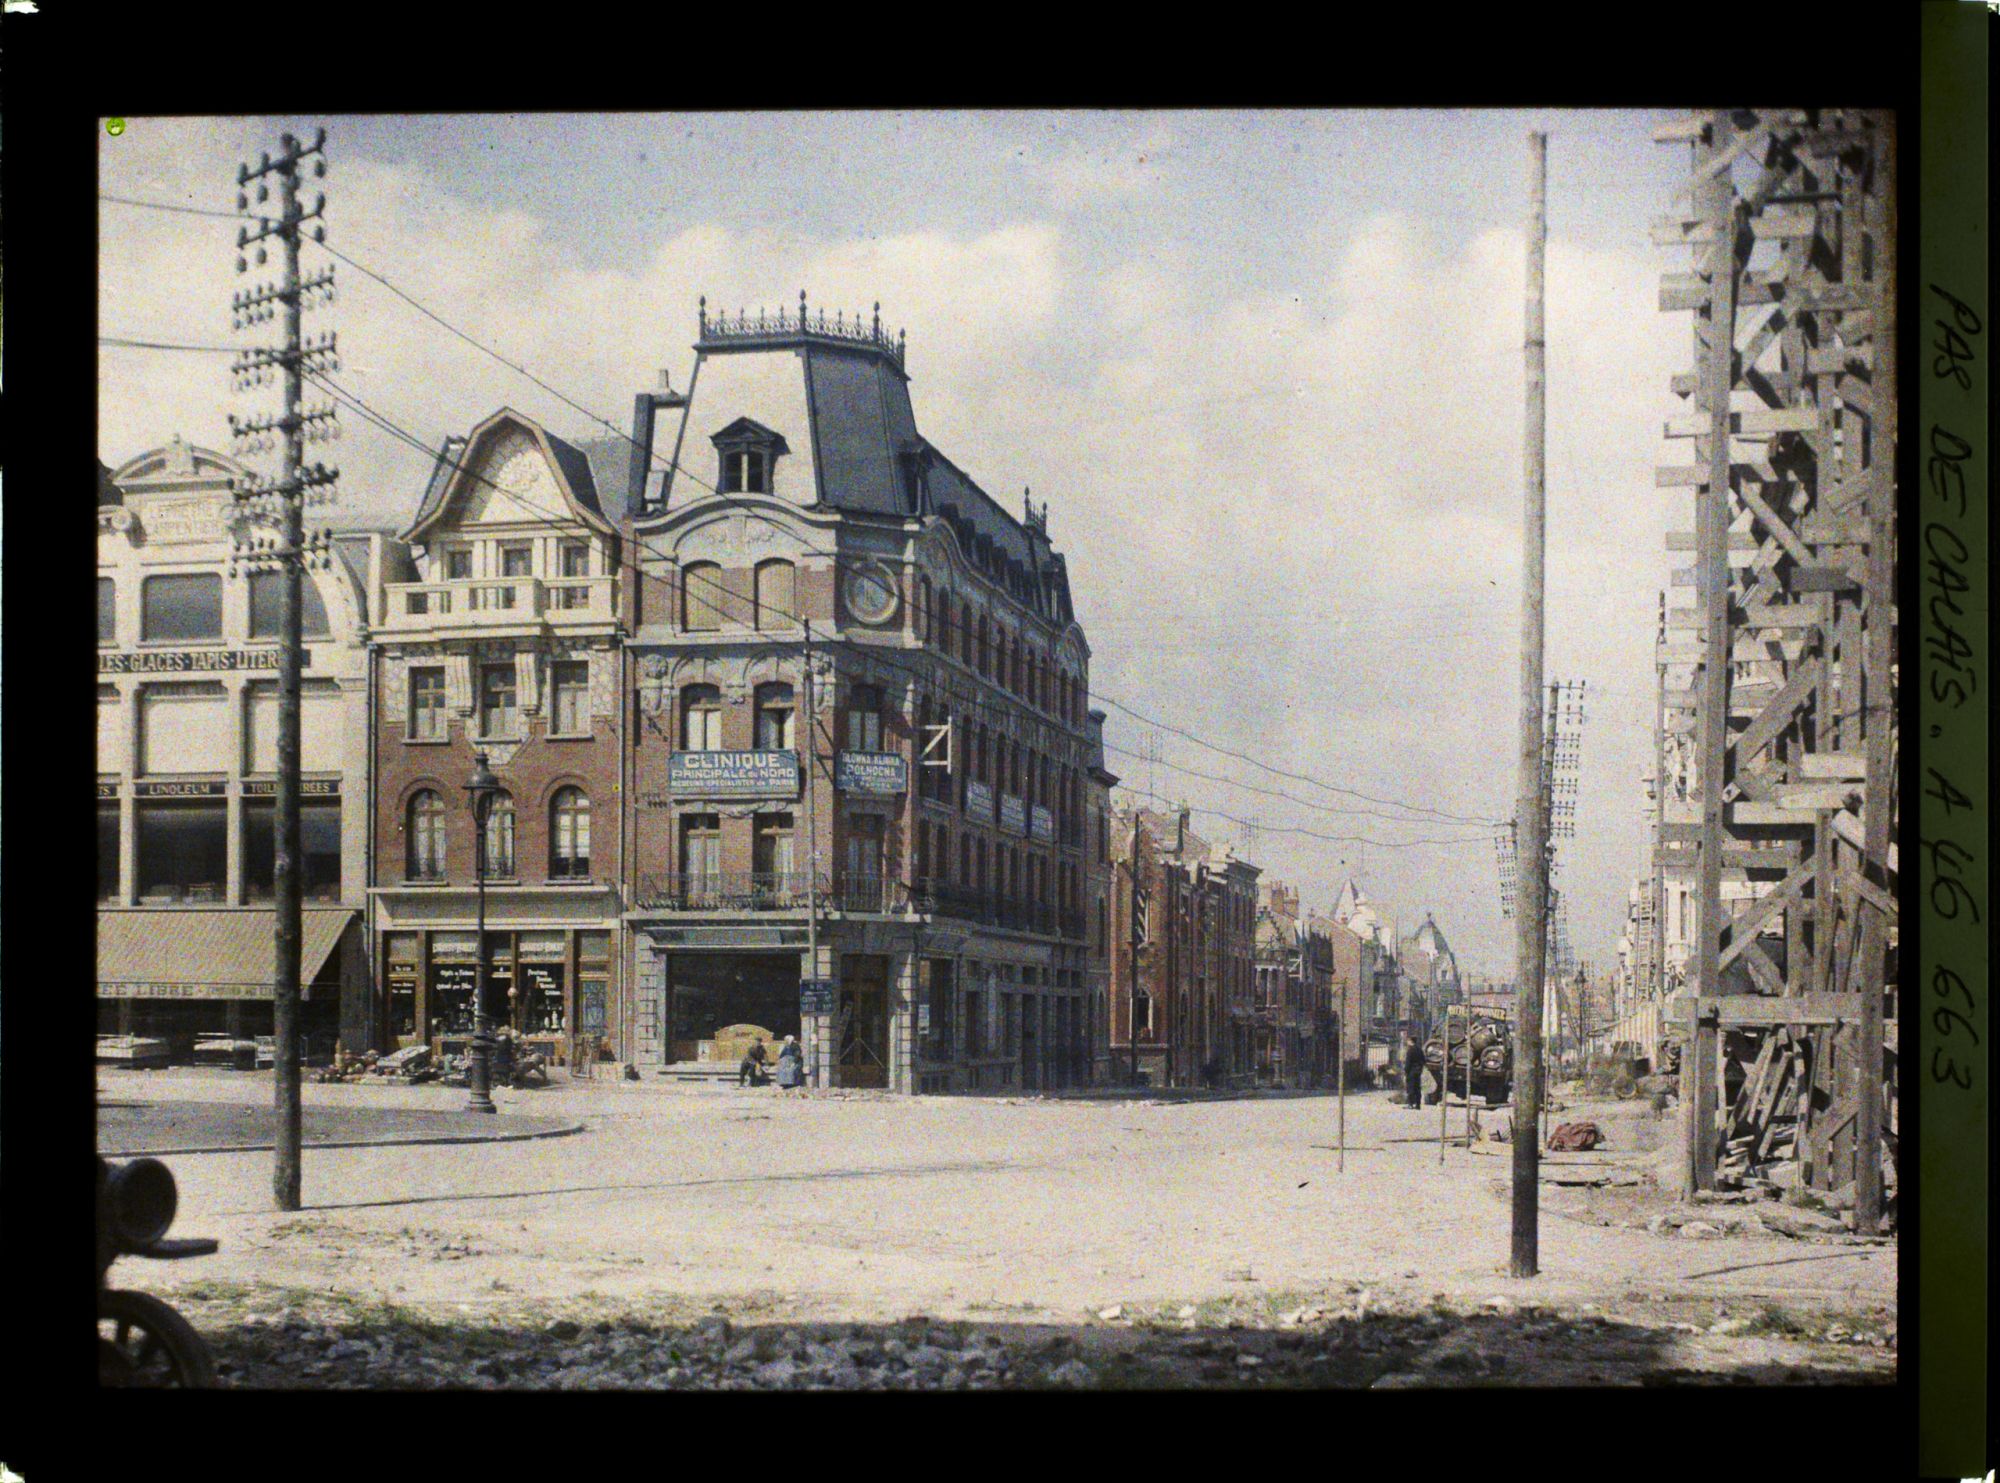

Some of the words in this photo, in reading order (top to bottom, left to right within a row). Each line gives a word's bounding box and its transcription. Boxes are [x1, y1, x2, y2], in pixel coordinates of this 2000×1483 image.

[1928, 283, 1982, 391] PAS
[1927, 423, 1973, 518] DE
[130, 653, 184, 672] GLACES
[190, 651, 230, 670] TAPIS
[236, 650, 280, 670] LITER
[685, 753, 780, 769] CLINIQUE
[671, 768, 747, 779] PRINCIPALE
[760, 768, 795, 778] NORD
[150, 783, 211, 795] LINOLEUM
[251, 782, 277, 794] TOIL
[137, 984, 194, 996] LIBRE
[1930, 963, 1980, 1091] 663
